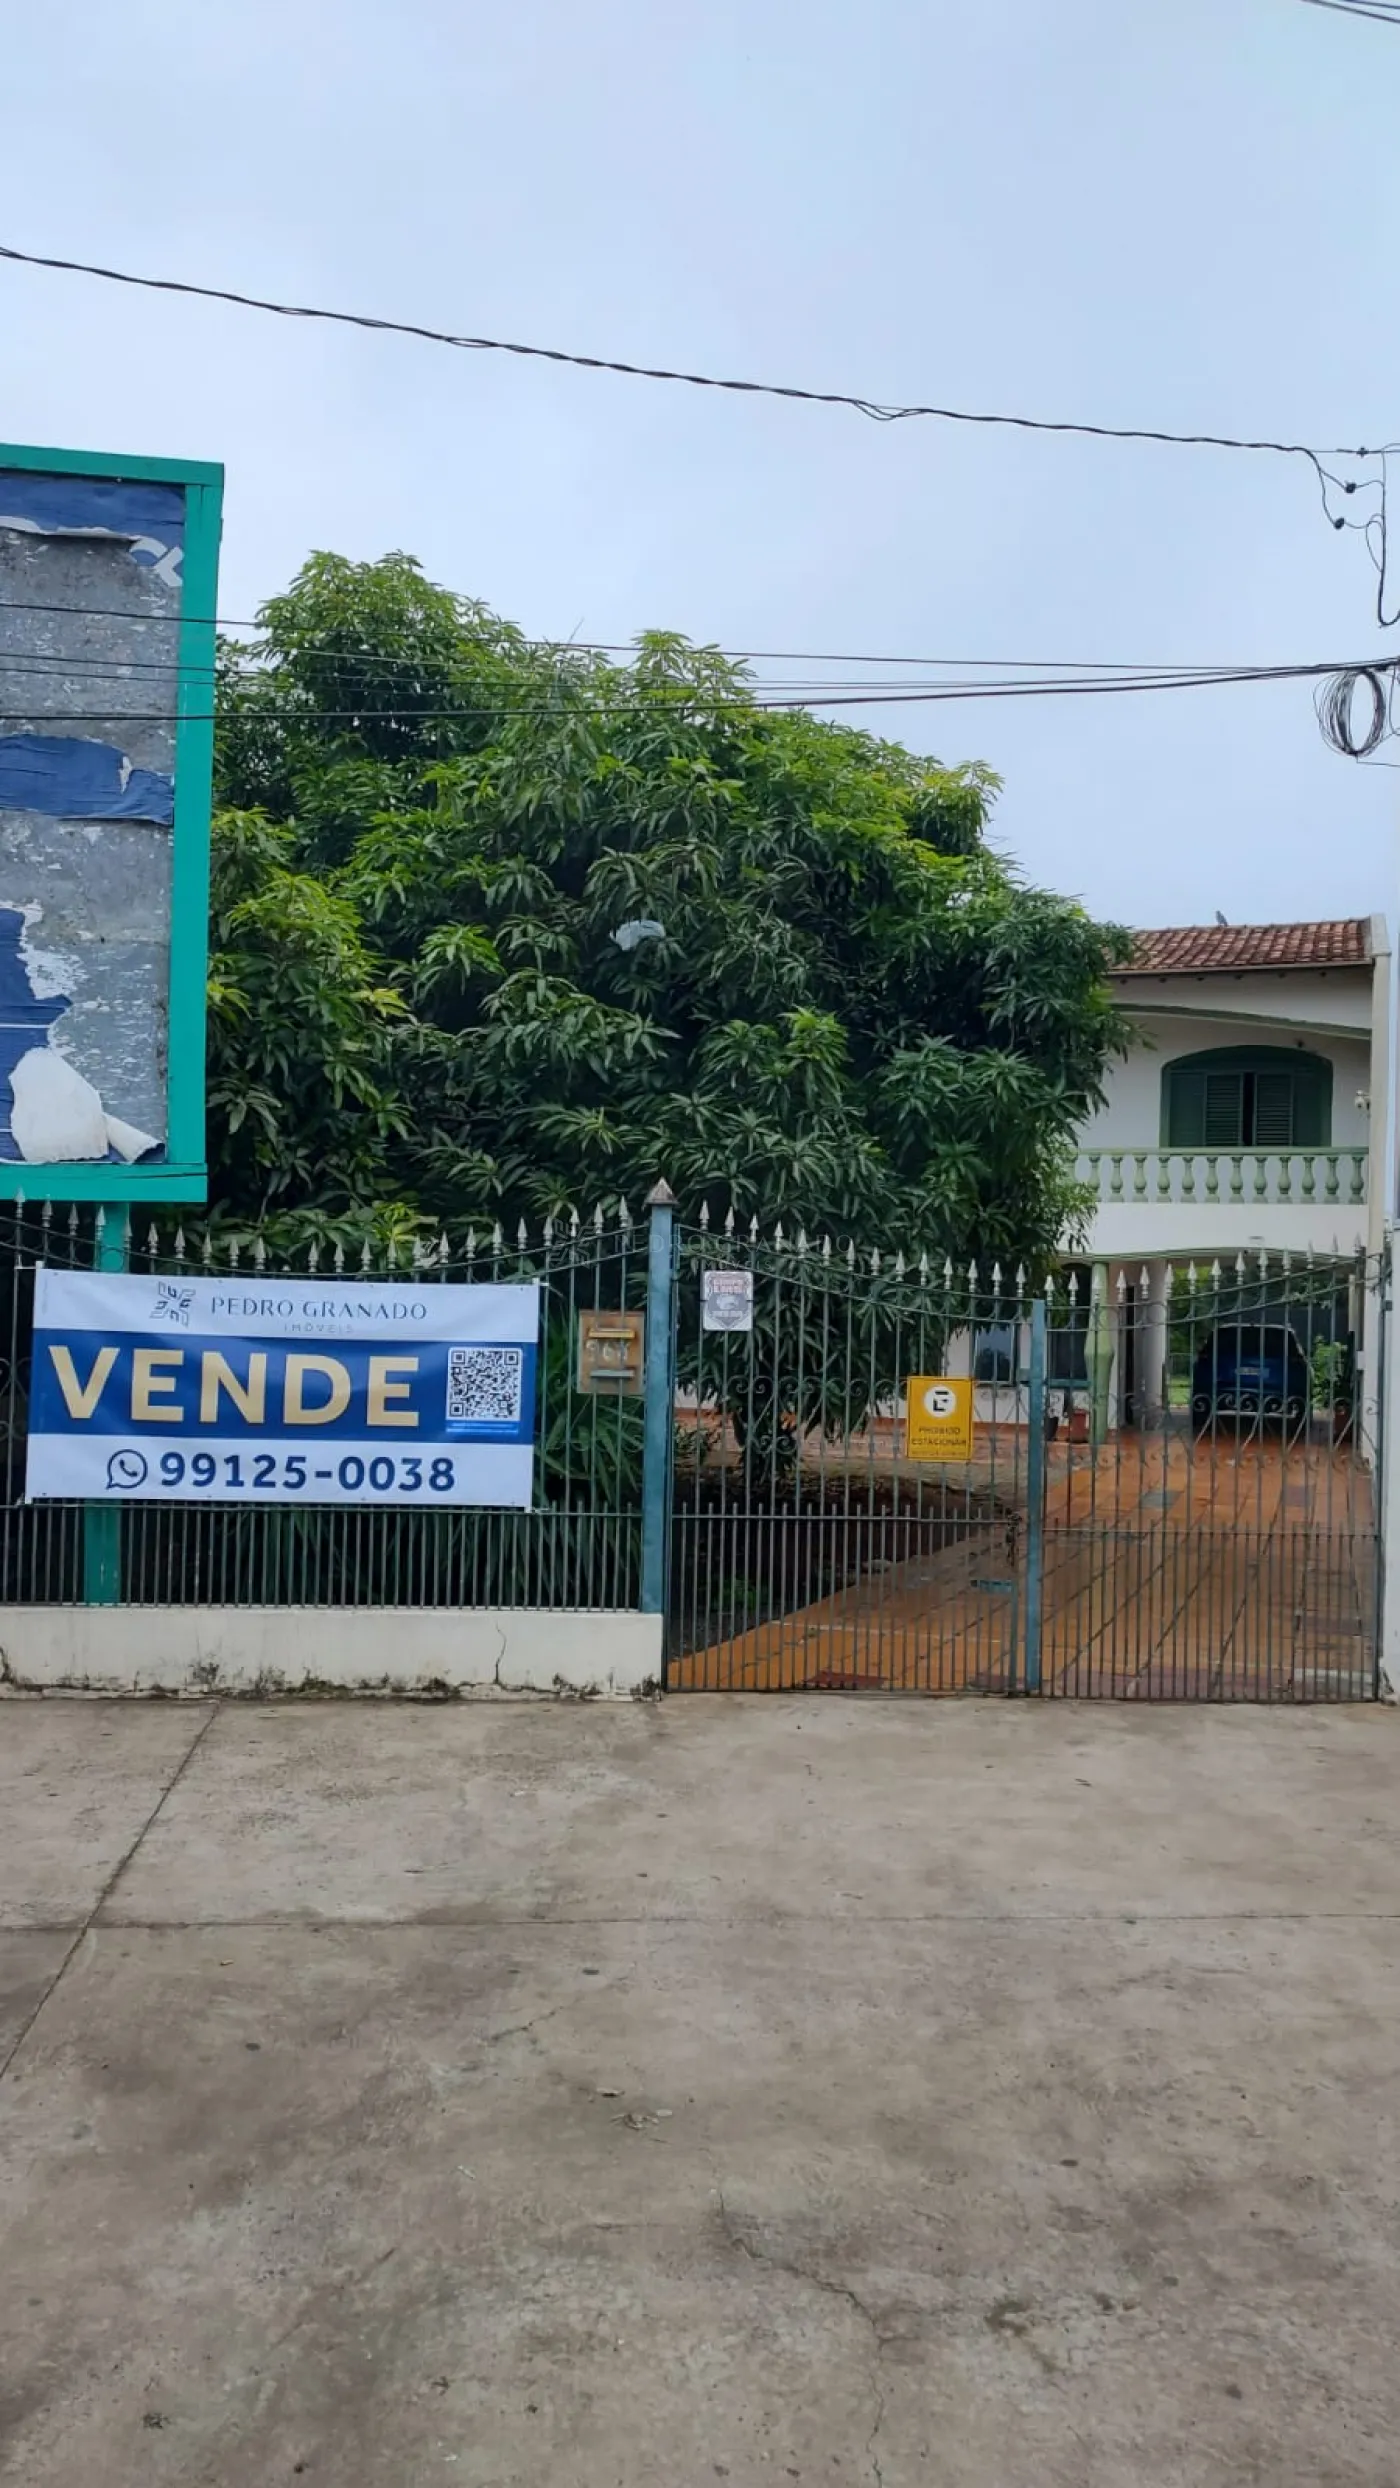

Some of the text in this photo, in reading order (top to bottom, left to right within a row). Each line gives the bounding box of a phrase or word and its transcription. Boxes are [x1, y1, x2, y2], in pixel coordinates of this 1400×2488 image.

[211, 1296, 427, 1320] PEDRO GRANADO
[49, 1345, 419, 1427] VENDE
[160, 1451, 455, 1491] 99125-0038
